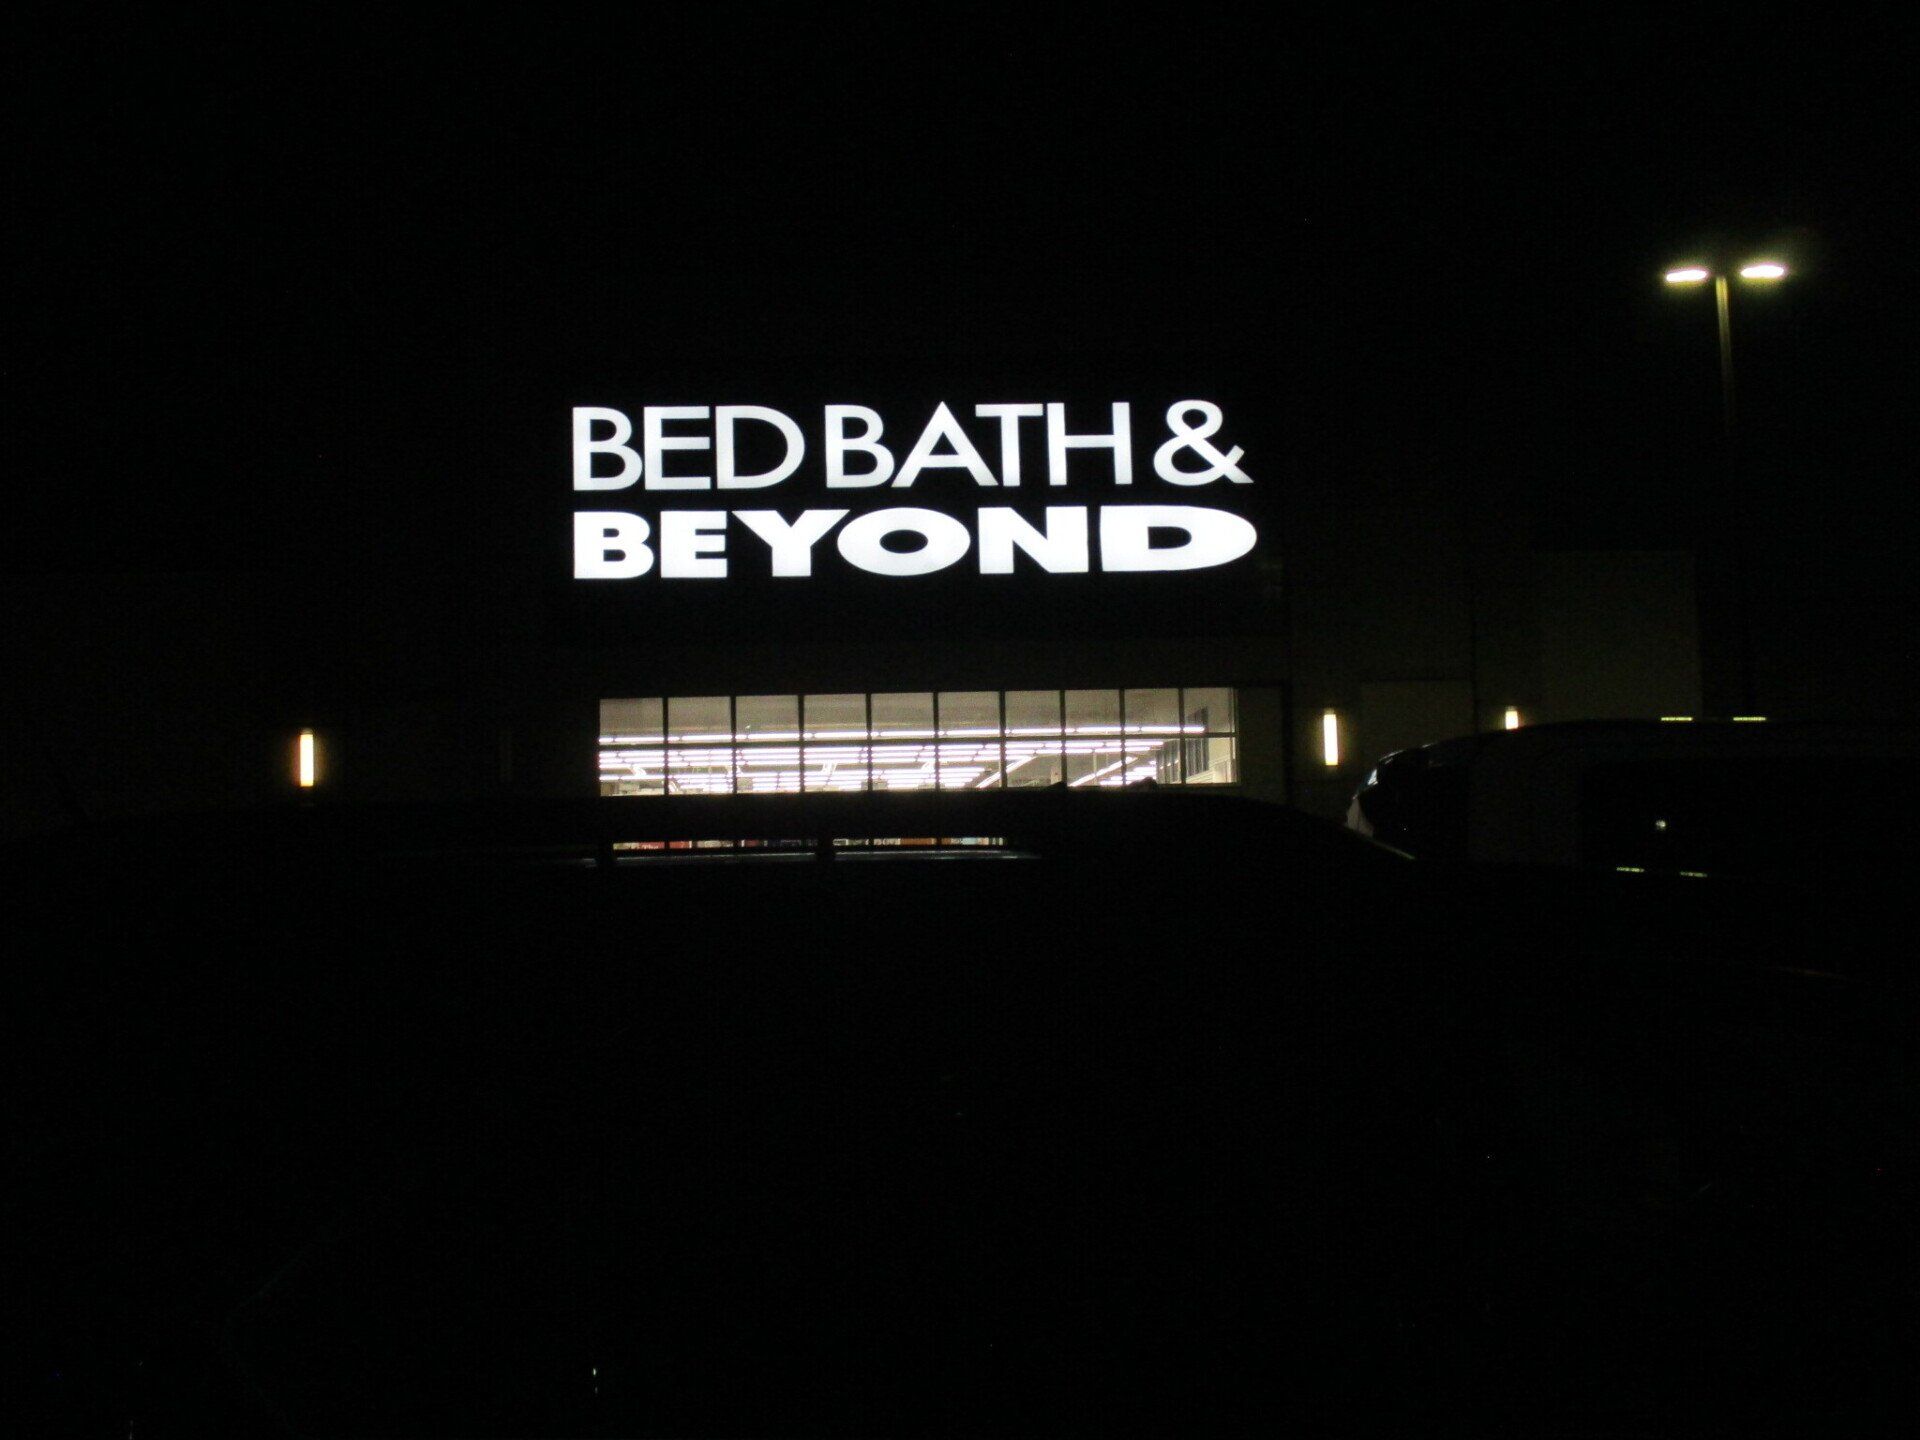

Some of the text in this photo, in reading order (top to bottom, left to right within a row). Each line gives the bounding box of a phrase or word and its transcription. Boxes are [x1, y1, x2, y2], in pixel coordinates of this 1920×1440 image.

[573, 400, 1253, 490] BED BATH &
[574, 505, 1257, 579] BEYOND
